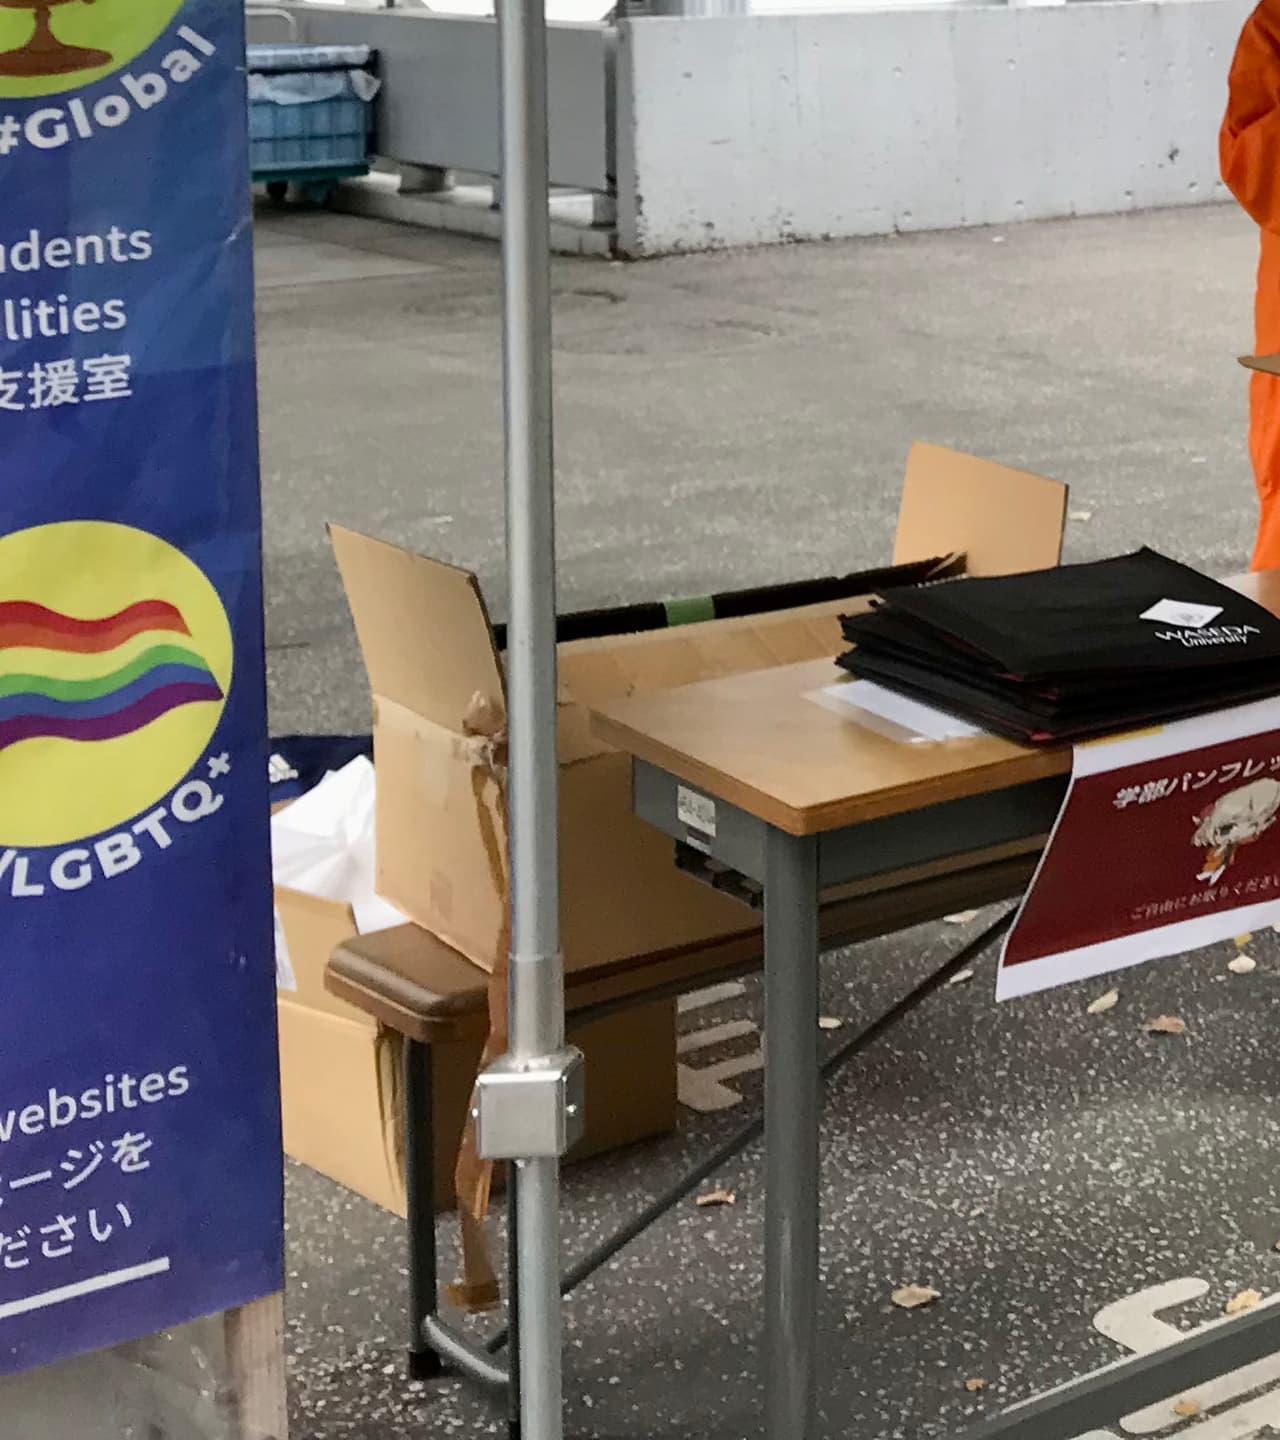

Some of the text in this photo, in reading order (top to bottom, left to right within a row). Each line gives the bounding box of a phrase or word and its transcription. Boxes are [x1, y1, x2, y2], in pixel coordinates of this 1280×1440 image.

[0, 224, 153, 274] dents
[4, 292, 128, 342] lities
[1154, 623, 1261, 641] WASEDA
[0, 1129, 153, 1205] ージを
